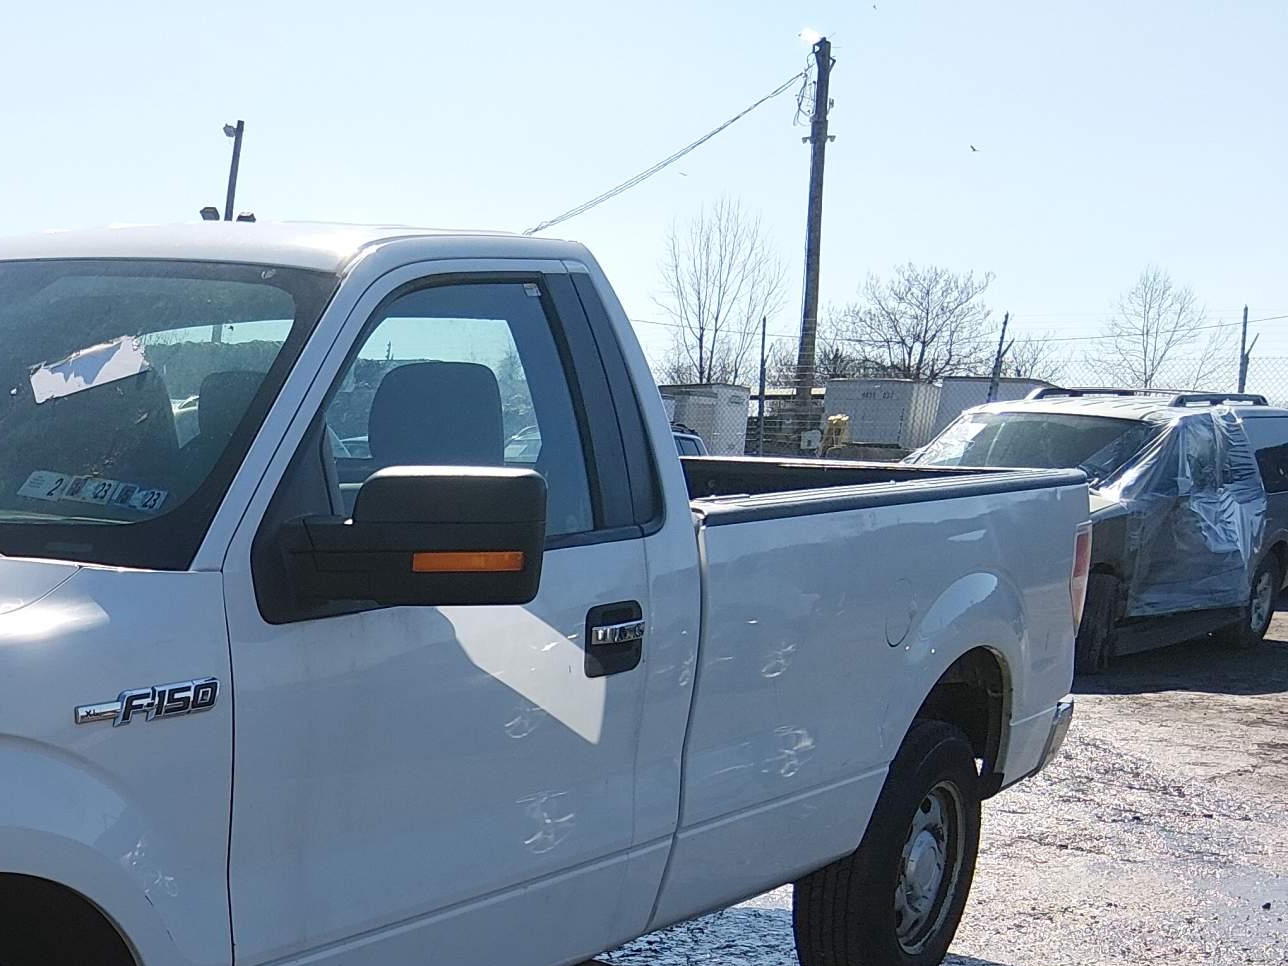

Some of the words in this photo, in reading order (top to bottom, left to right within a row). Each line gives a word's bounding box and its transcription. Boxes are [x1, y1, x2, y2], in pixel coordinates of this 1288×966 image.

[46, 477, 64, 497] 2
[93, 481, 113, 500] 23
[141, 490, 161, 510] 23
[117, 680, 220, 724] F-150
